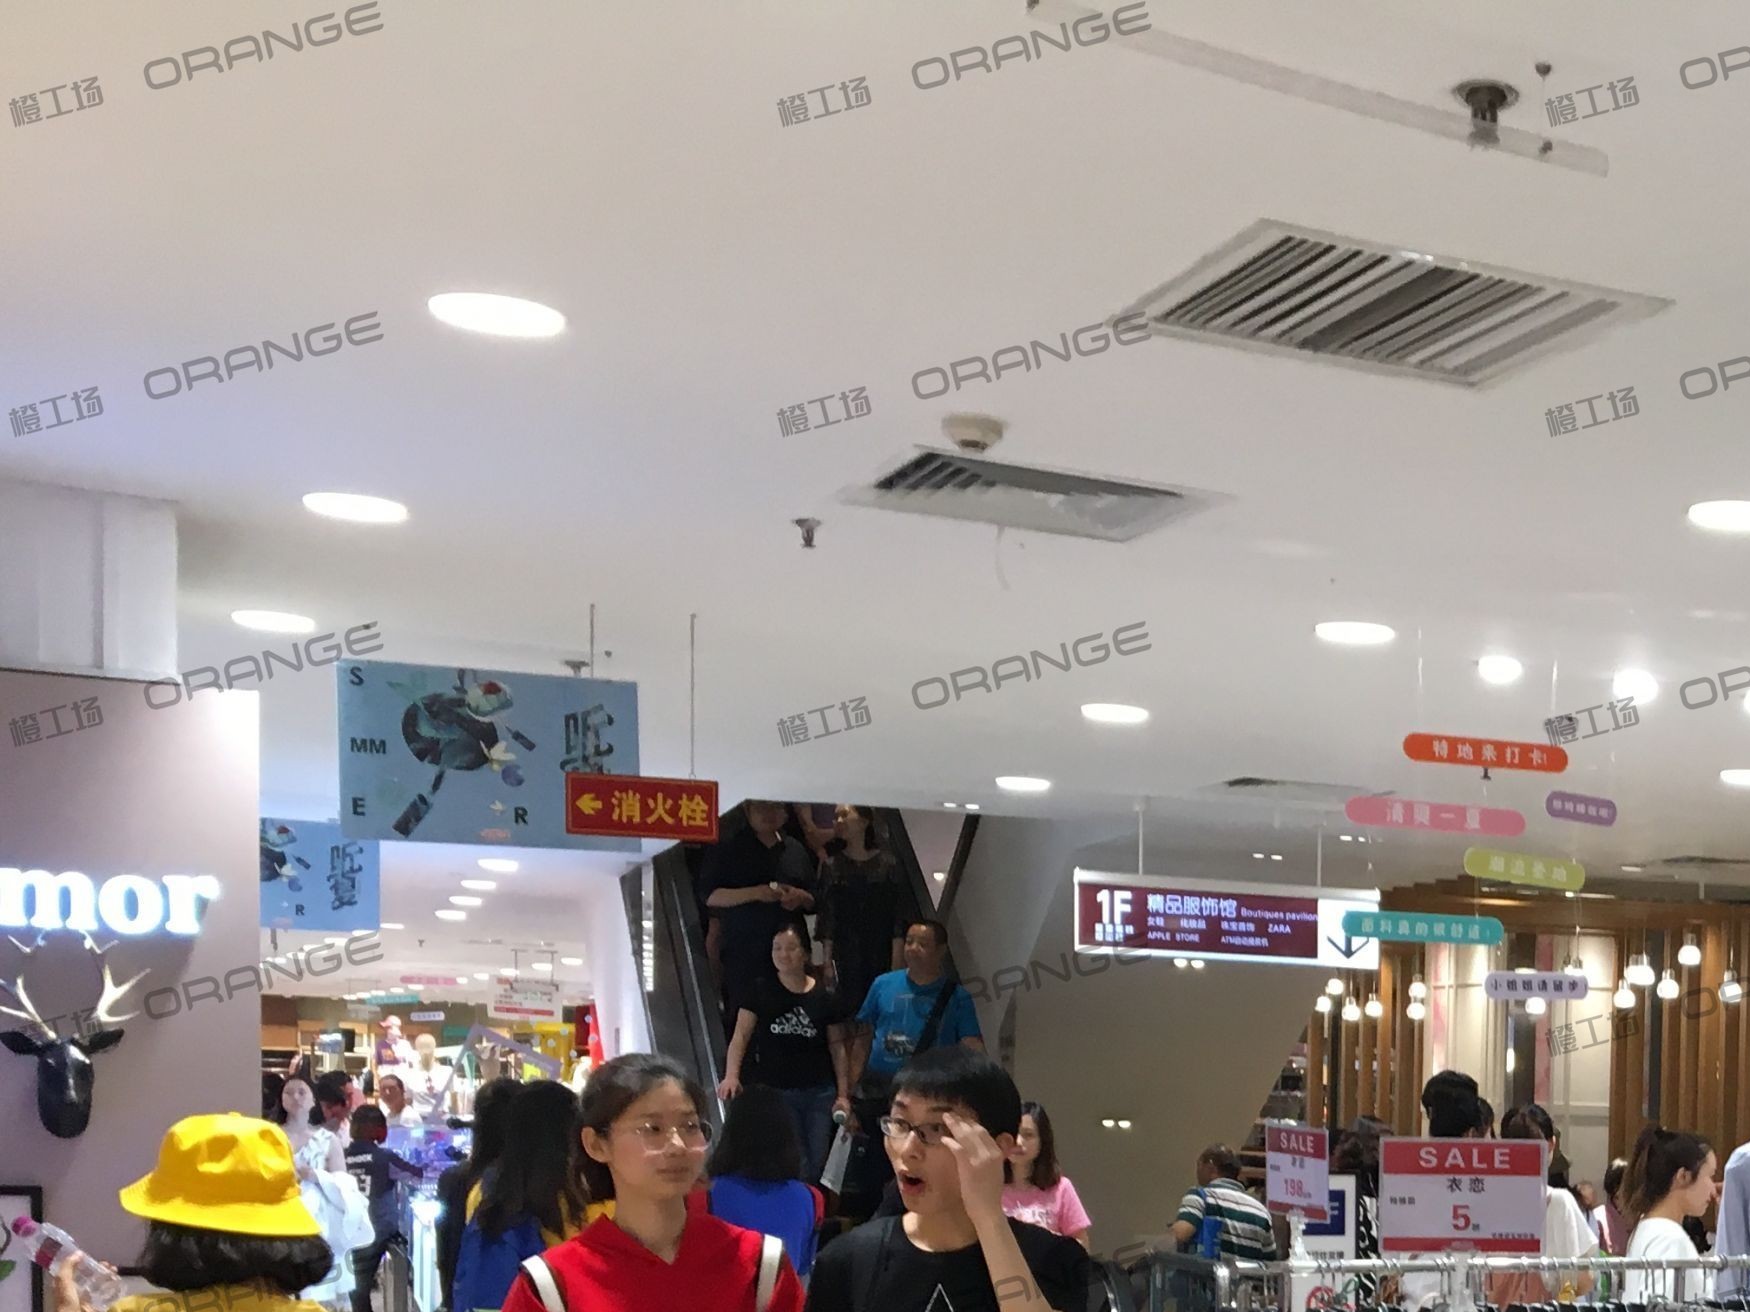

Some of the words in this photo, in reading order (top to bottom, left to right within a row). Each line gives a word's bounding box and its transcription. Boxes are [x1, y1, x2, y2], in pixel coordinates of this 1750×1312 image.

[349, 666, 364, 686] S
[352, 797, 366, 816] E
[514, 806, 528, 825] R
[612, 790, 709, 826] 消火栓
[1096, 888, 1133, 925] 1F
[1146, 893, 1237, 919] 精品服饰馆
[1268, 923, 1292, 935] ZARA
[770, 1019, 817, 1038] adidas
[1280, 1131, 1314, 1154] SALE
[1418, 1146, 1511, 1169] SALE
[1284, 1178, 1304, 1198] 198
[1447, 1176, 1486, 1193] 衣恋
